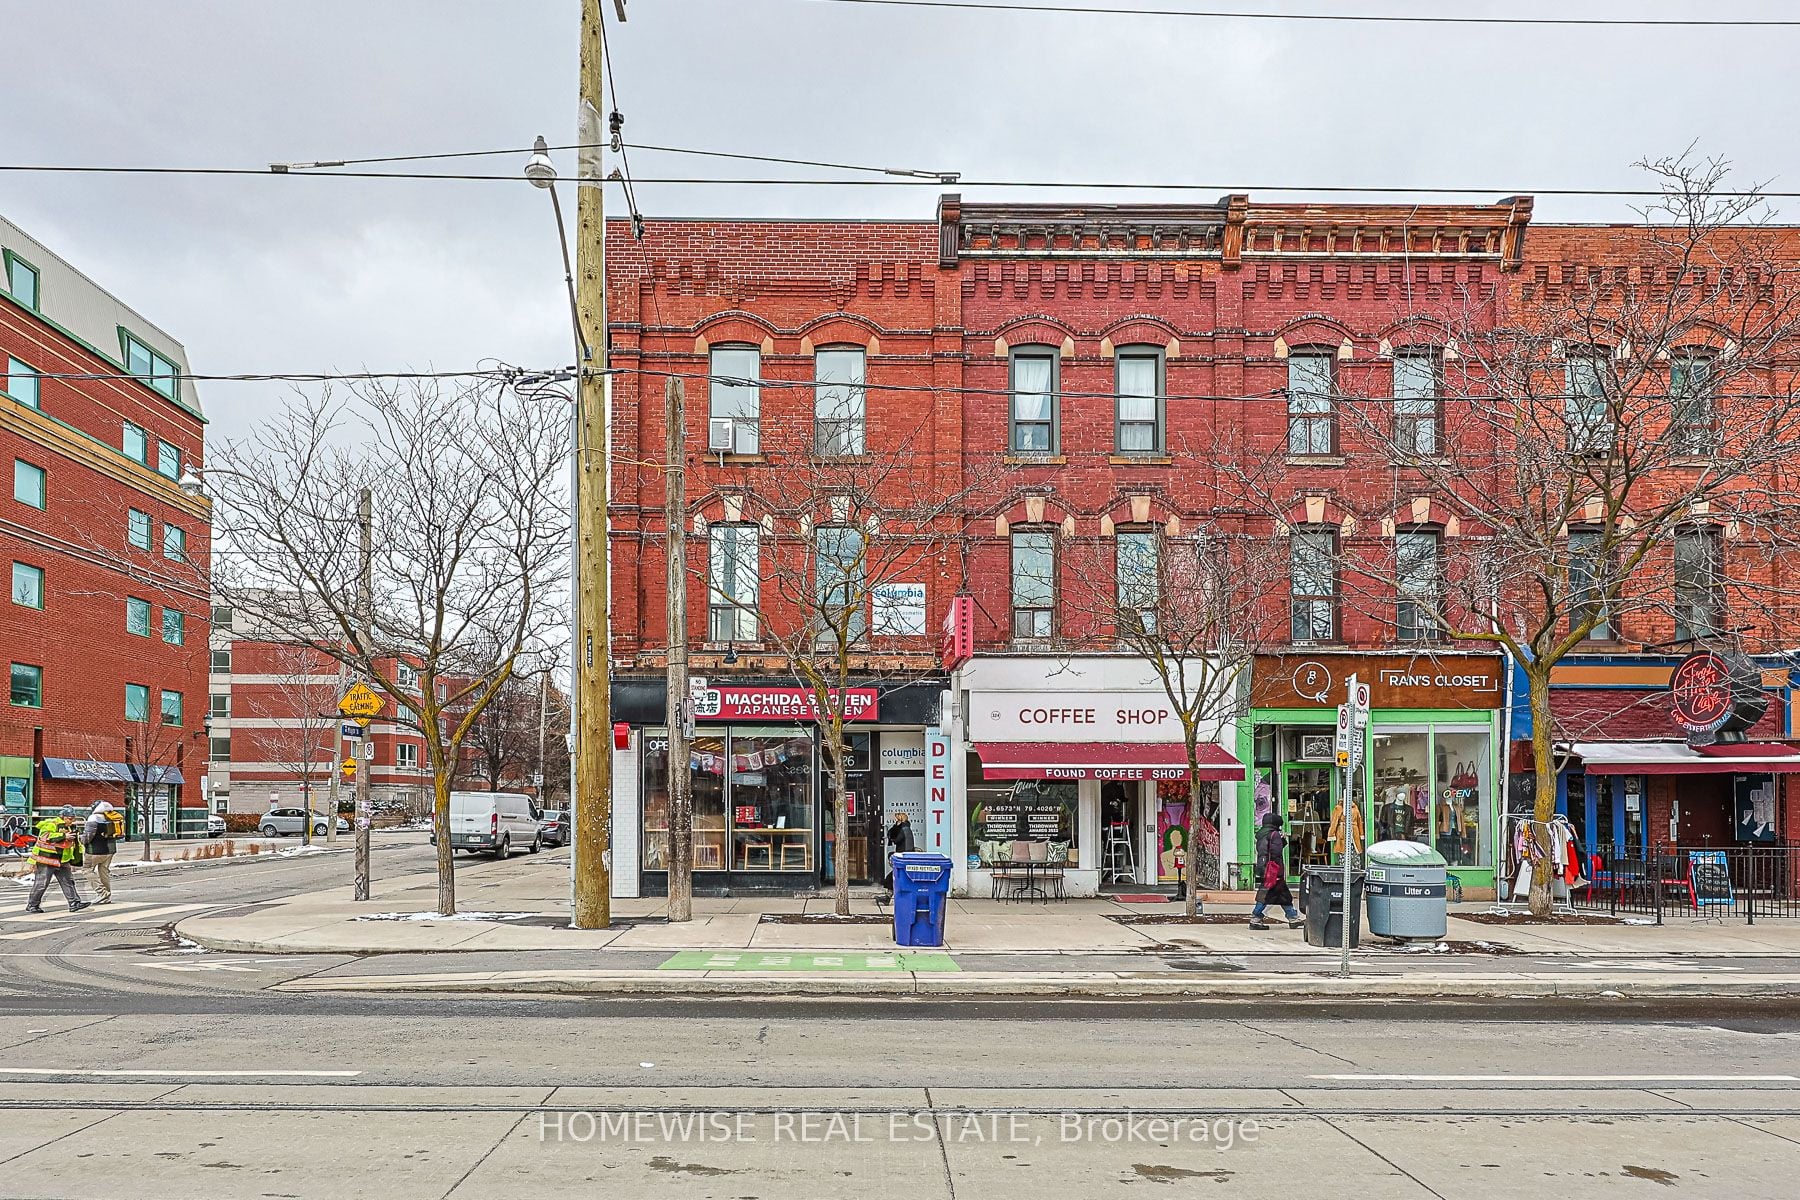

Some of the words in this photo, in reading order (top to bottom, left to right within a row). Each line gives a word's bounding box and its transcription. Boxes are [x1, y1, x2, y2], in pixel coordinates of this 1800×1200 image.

[875, 588, 923, 598] columbia
[1389, 675, 1430, 686] RAN'S
[1434, 675, 1488, 687] CLOSET
[350, 692, 371, 701] TRAFFIC
[725, 694, 802, 705] MACHIDA
[806, 694, 872, 706] SOTEN
[349, 702, 373, 710] CALMING
[735, 705, 807, 714] JAPANESE
[813, 706, 862, 715] RAEN
[1019, 708, 1096, 724] COFFEE
[1116, 709, 1169, 724] SHOP
[649, 740, 669, 751] OPE
[882, 748, 925, 757] columbia
[1045, 769, 1086, 779] FOUND
[1094, 769, 1143, 779] COFFEE
[1152, 769, 1184, 779] SHOP
[931, 742, 945, 848] DENTI
[1443, 789, 1471, 798] OPEN
[1370, 885, 1383, 893] Litter
[1404, 887, 1422, 895] Litter
